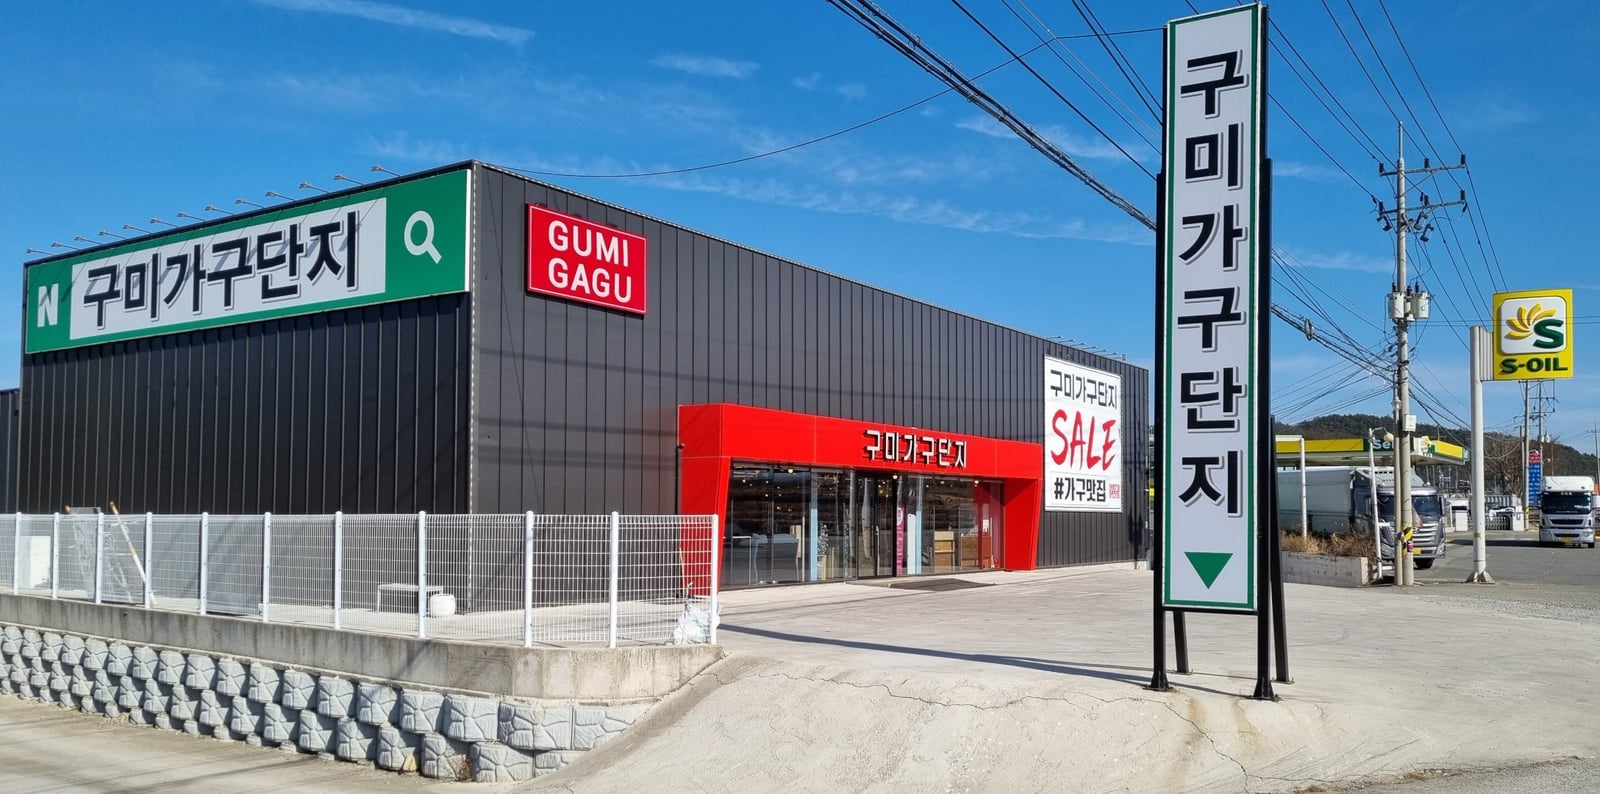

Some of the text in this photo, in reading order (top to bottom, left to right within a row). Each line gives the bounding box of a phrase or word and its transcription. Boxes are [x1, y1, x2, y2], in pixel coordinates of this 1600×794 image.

[548, 220, 629, 267] GUMI
[83, 210, 357, 328] 구미가구단지
[548, 258, 632, 303] GAGU
[1177, 49, 1246, 517] 구미가구단지
[37, 283, 59, 327] N
[1533, 319, 1564, 349] S
[1500, 357, 1568, 374] S-OIL
[1050, 369, 1118, 410] 구미가구단지
[864, 429, 967, 469] 구미가구단지
[1051, 409, 1117, 471] SALE
[1372, 438, 1396, 450] Sel
[1054, 477, 1106, 502] #가구맛집
